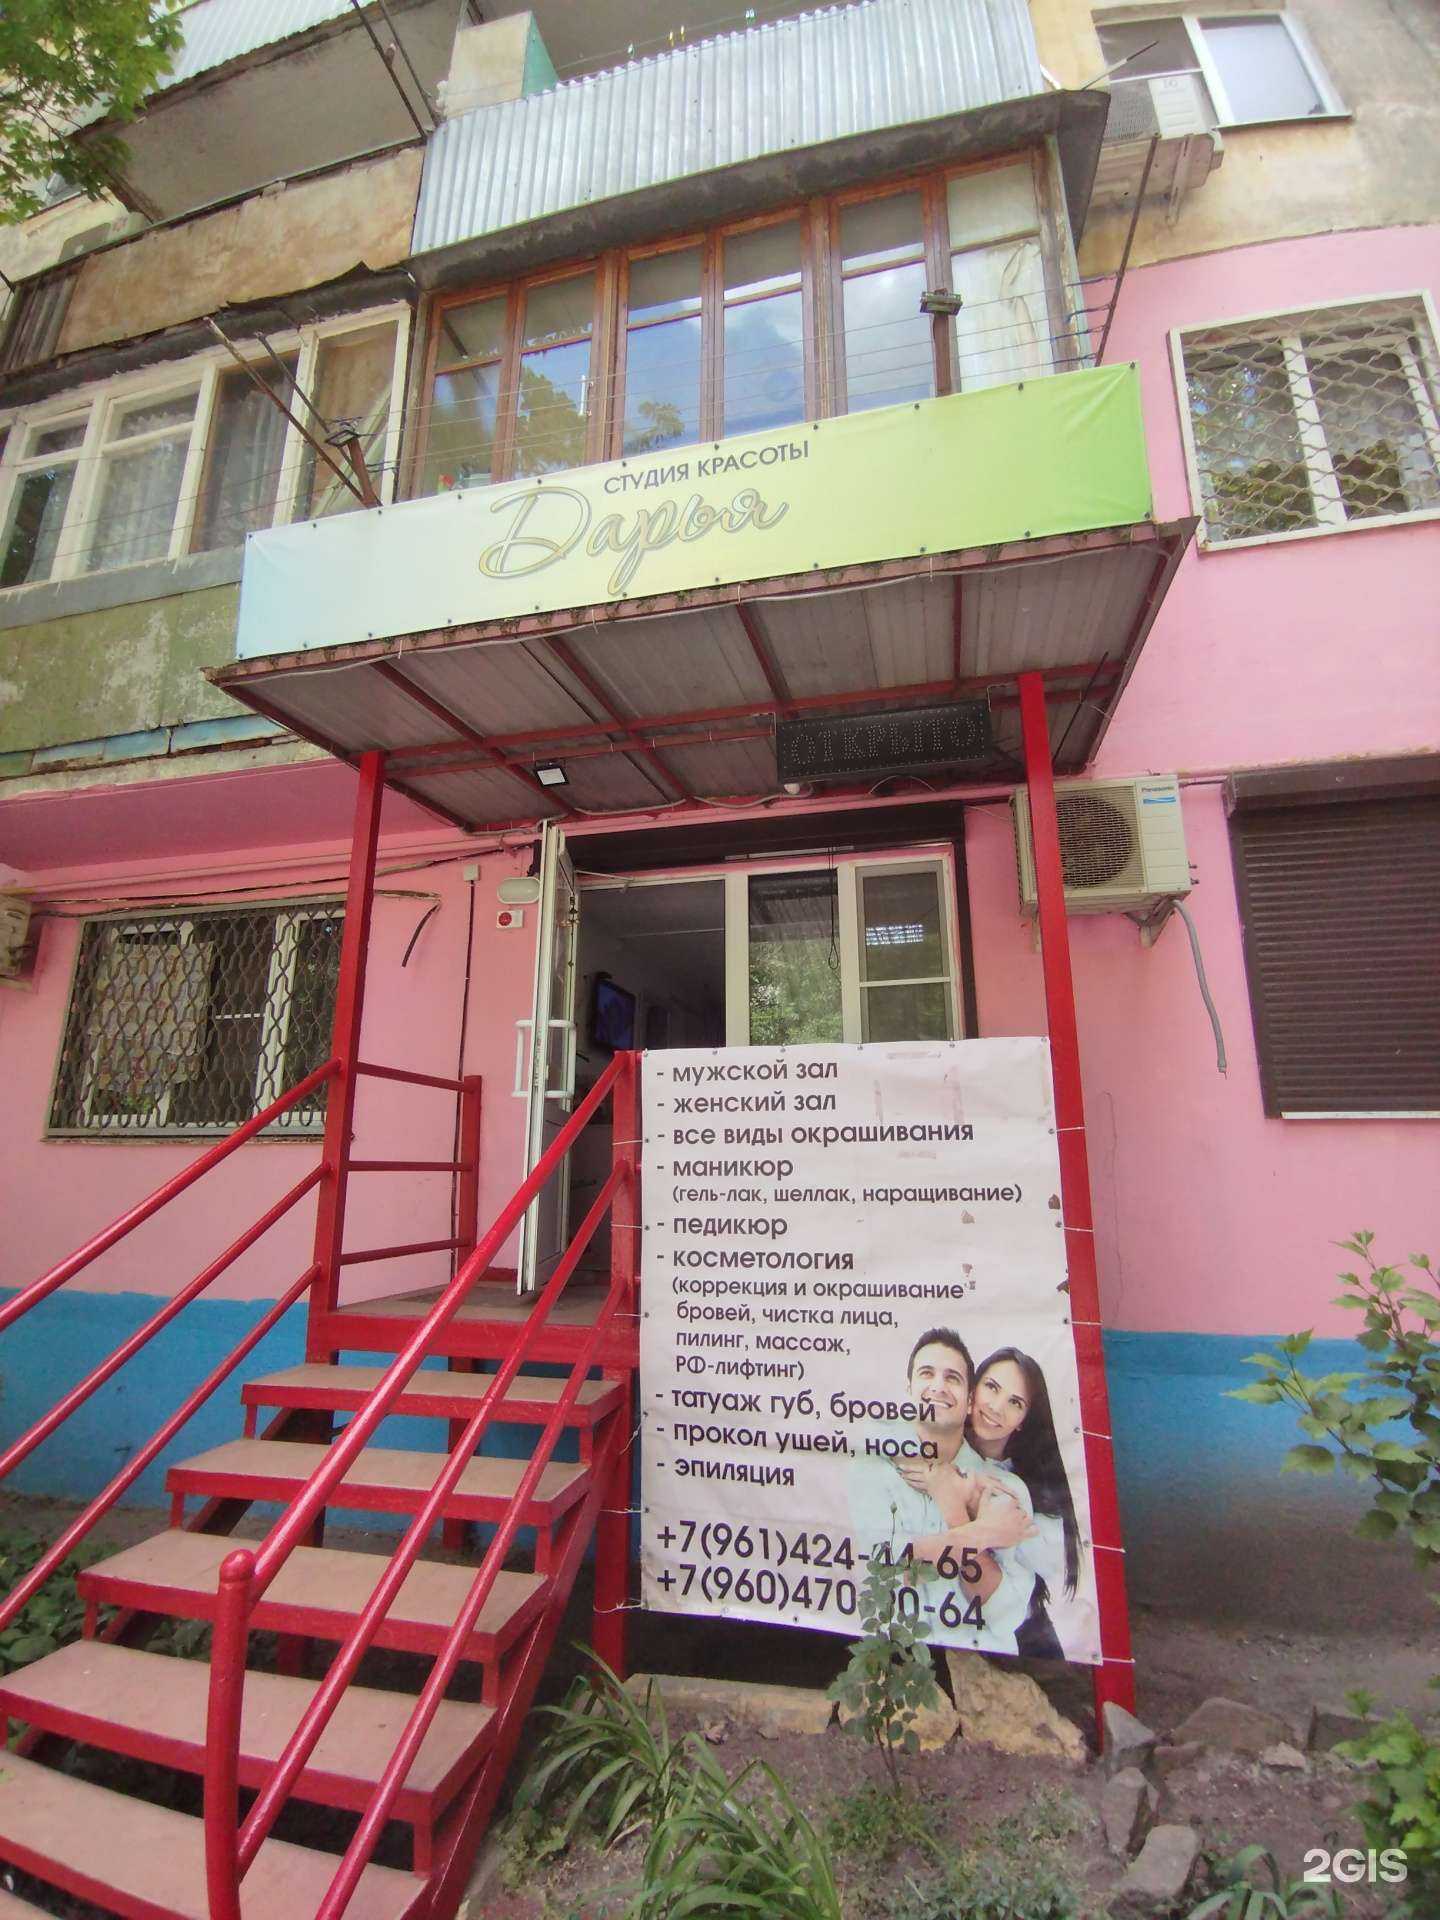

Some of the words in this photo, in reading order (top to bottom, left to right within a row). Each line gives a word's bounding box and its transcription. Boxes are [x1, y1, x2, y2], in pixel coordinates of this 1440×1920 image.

[603, 463, 689, 495] СТУДИЯ
[697, 440, 809, 477] КРАСОТЫ
[478, 485, 788, 596] Дарья
[672, 1057, 789, 1085] мужской
[796, 1060, 838, 1080] зал
[673, 1090, 786, 1113] женский
[794, 1093, 836, 1112] зал
[673, 1126, 716, 1145] все
[724, 1125, 783, 1146] виды
[791, 1121, 974, 1146] окрашивания
[672, 1157, 794, 1181] маникюр
[672, 1185, 768, 1205] (гель-лак,
[774, 1185, 857, 1205] шеллак,
[863, 1184, 1022, 1205] наращивание)
[673, 1215, 789, 1240] педикюр
[673, 1248, 854, 1271] косметология
[672, 1279, 788, 1298] (коррекция
[794, 1280, 807, 1296] и
[814, 1280, 965, 1300] окрашивание
[676, 1301, 756, 1325] бровей,
[762, 1307, 834, 1325] чистка
[840, 1308, 899, 1328] лица,
[675, 1328, 750, 1350] пилинг,
[755, 1334, 851, 1355] массаж,
[675, 1354, 805, 1380] РФ-лифтинг)
[672, 1388, 761, 1414] татуаж
[770, 1391, 821, 1419] губ,
[830, 1393, 936, 1424] бровей
[673, 1425, 768, 1448] прокол
[775, 1428, 856, 1457] ушей,
[865, 1436, 939, 1460] носа
[674, 1456, 795, 1486] эпиляция
